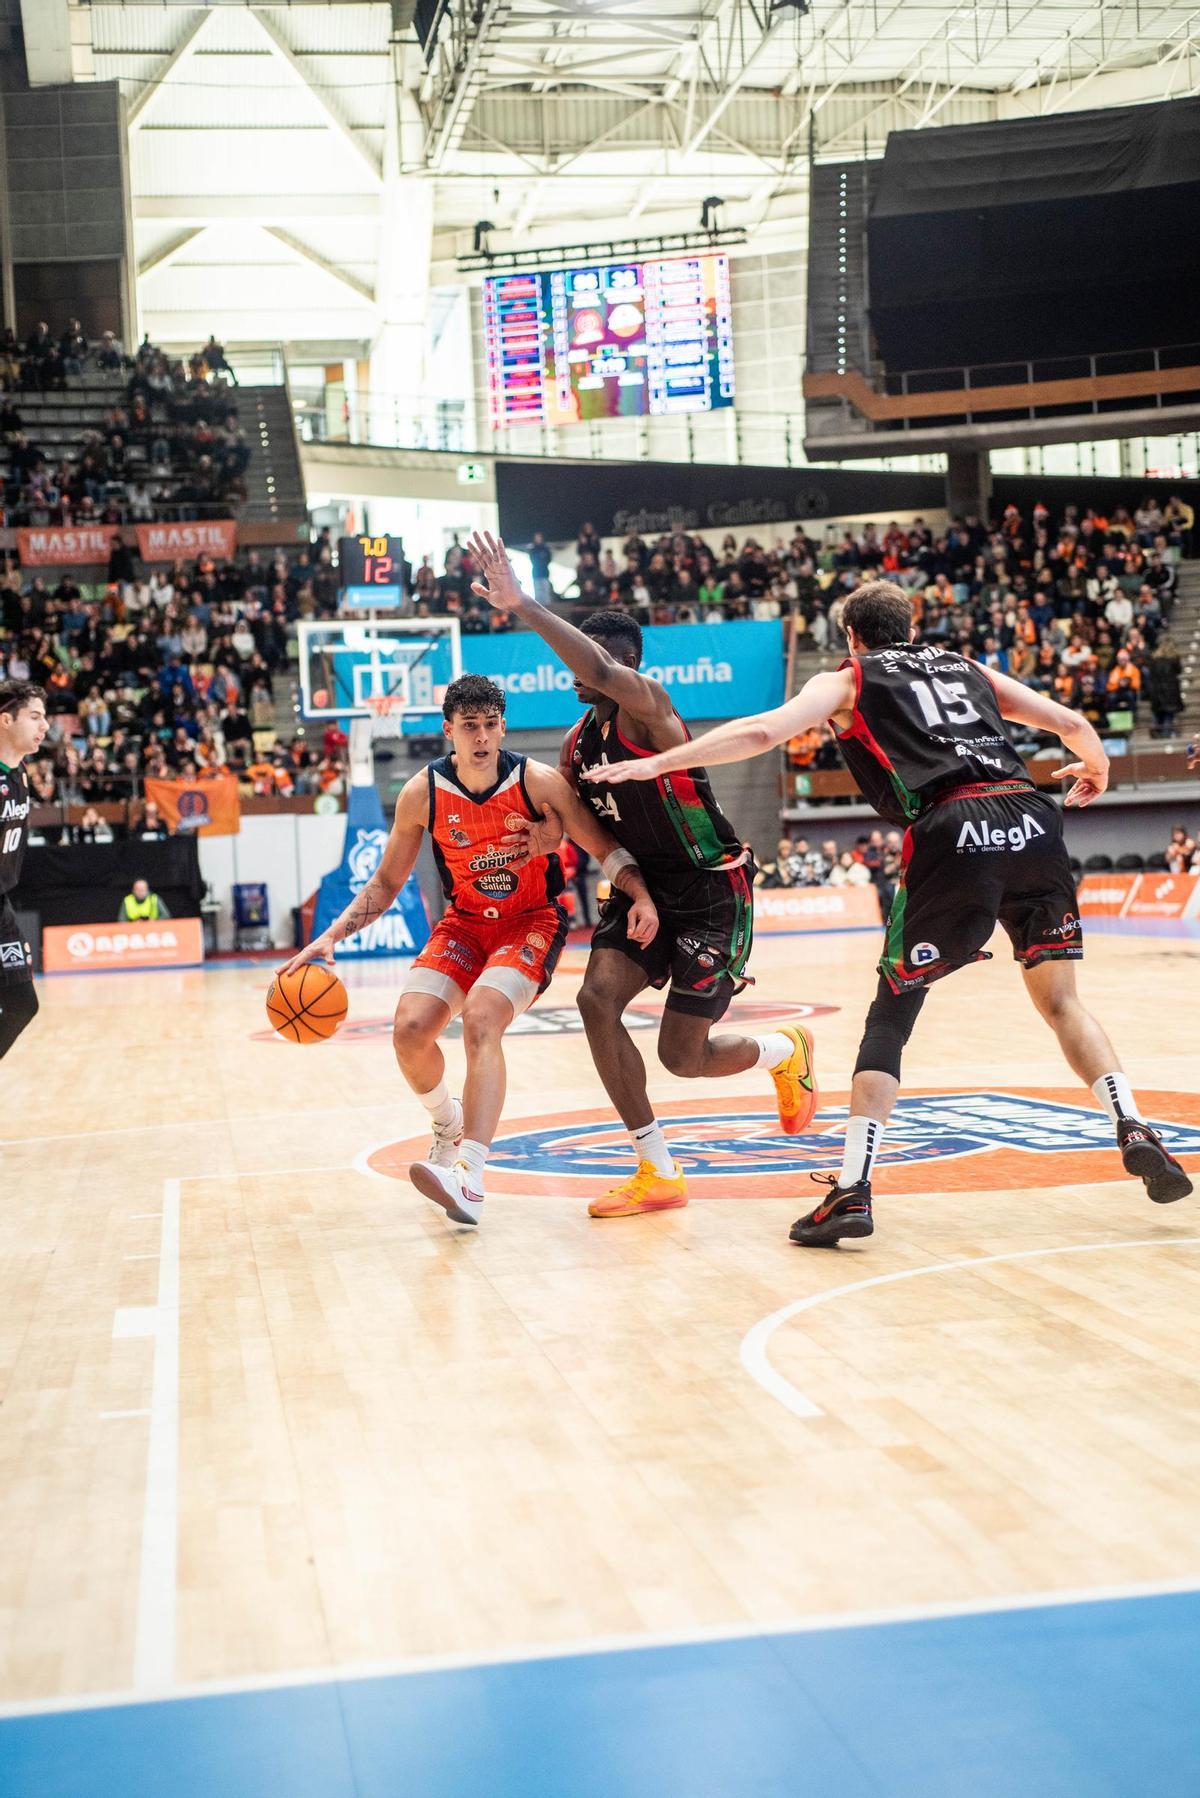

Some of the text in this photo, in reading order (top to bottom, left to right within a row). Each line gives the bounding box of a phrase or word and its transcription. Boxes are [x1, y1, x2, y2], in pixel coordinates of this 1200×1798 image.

[29, 531, 107, 551] MASTIL
[149, 527, 226, 546] MASTIL
[364, 556, 392, 584] 12
[487, 656, 733, 694] ncello oruña
[909, 678, 981, 728] 15
[2, 827, 22, 854] 10
[981, 845, 1005, 853] derecho
[479, 873, 512, 883] Estrella
[481, 882, 512, 891] Galicia
